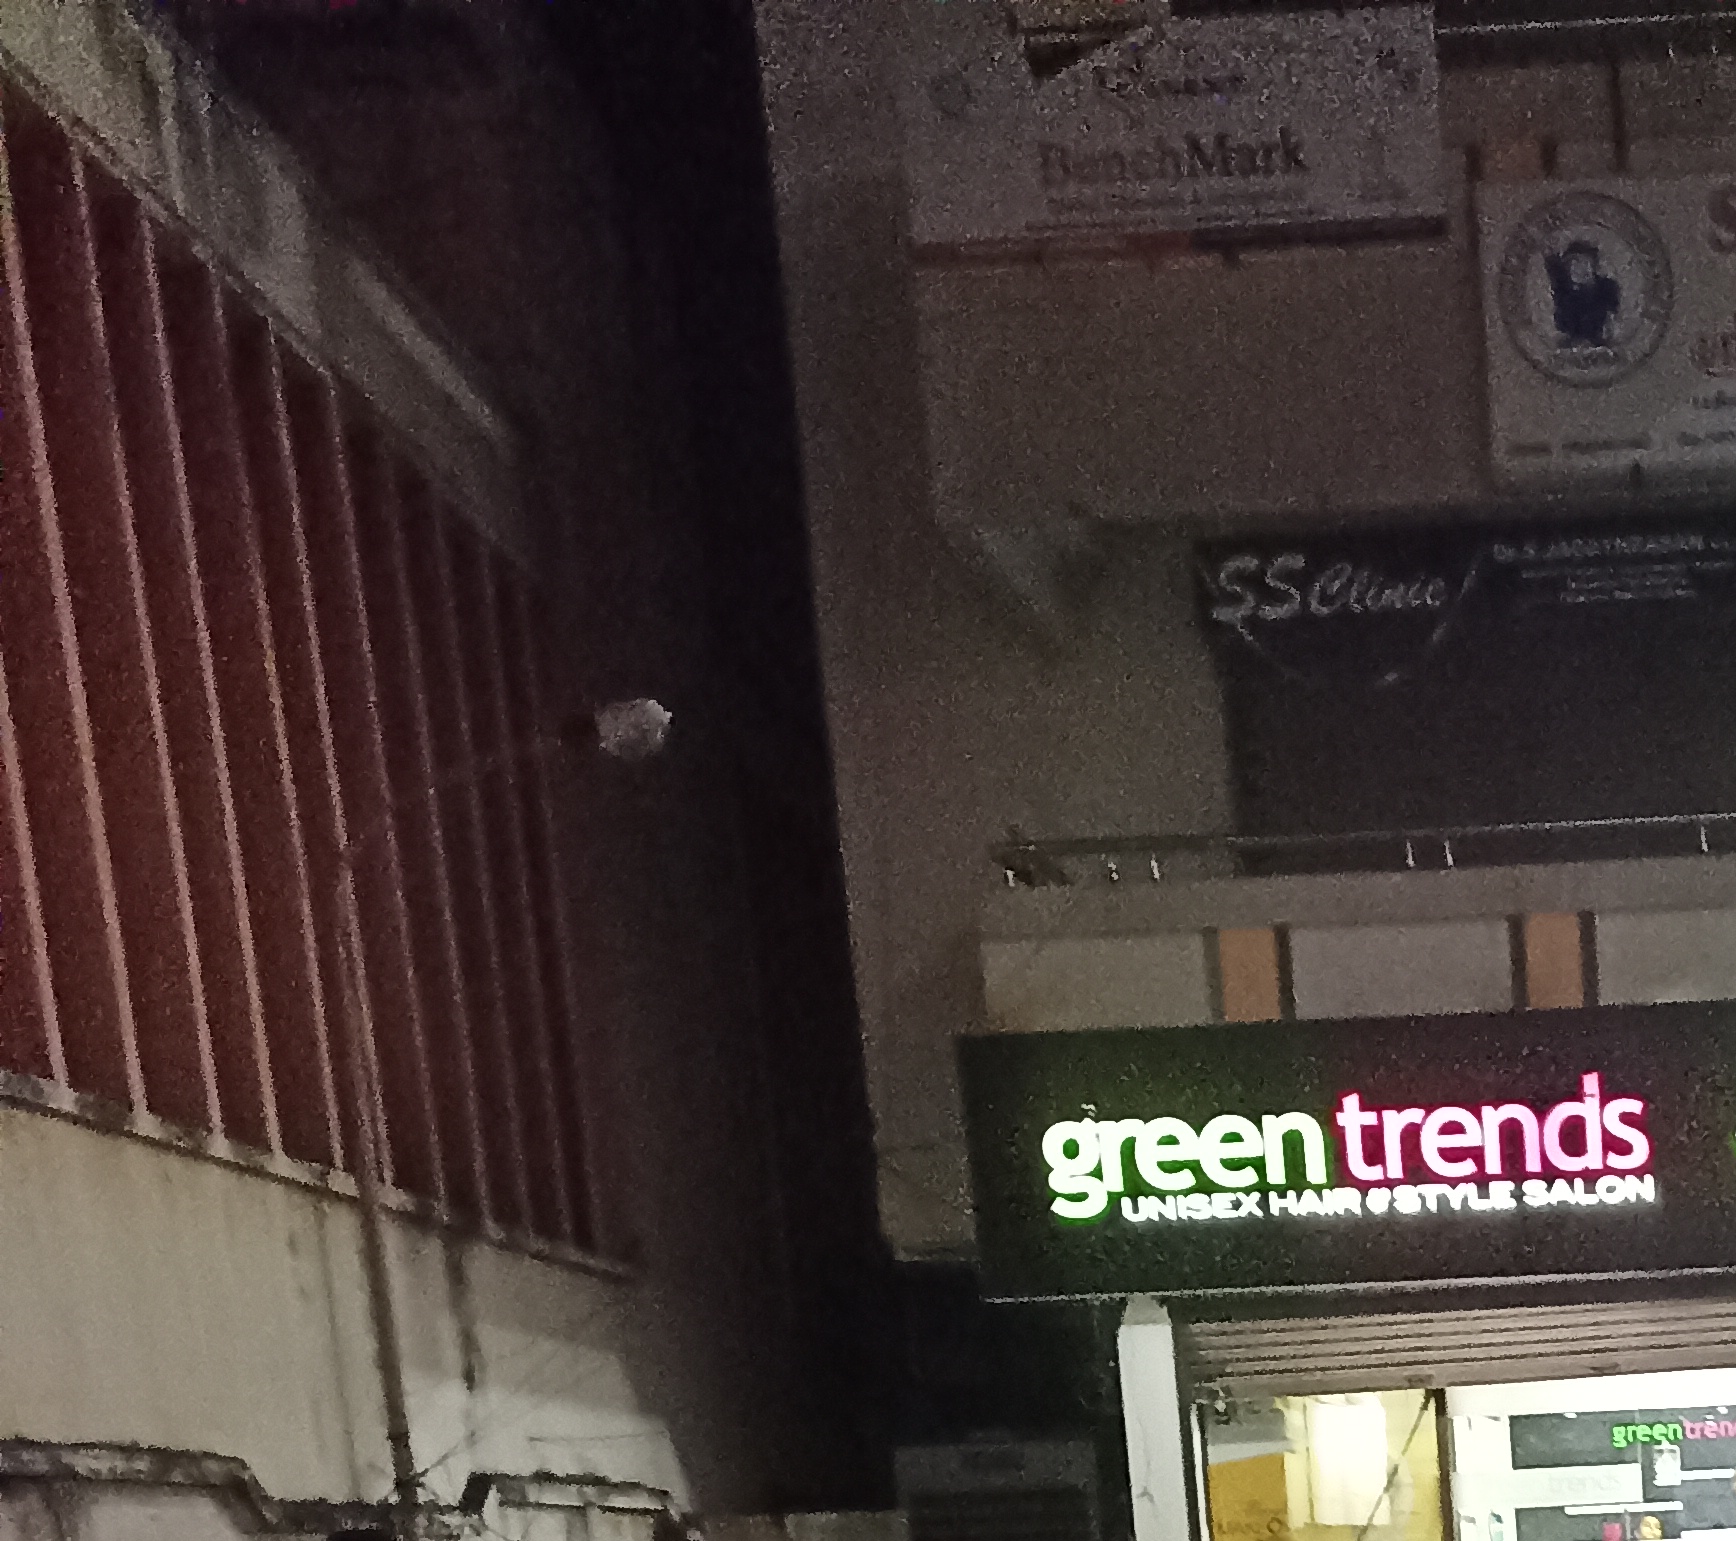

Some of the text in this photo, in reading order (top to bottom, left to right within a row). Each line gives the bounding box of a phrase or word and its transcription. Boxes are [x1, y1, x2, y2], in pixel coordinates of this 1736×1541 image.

[1042, 1071, 1651, 1219] green trends
[1121, 1188, 1264, 1222] UNISEX
[1269, 1186, 1363, 1218] HAIR
[1392, 1180, 1518, 1214] STYLE
[1519, 1173, 1656, 1207] SALON
[1612, 1420, 1682, 1448] green
